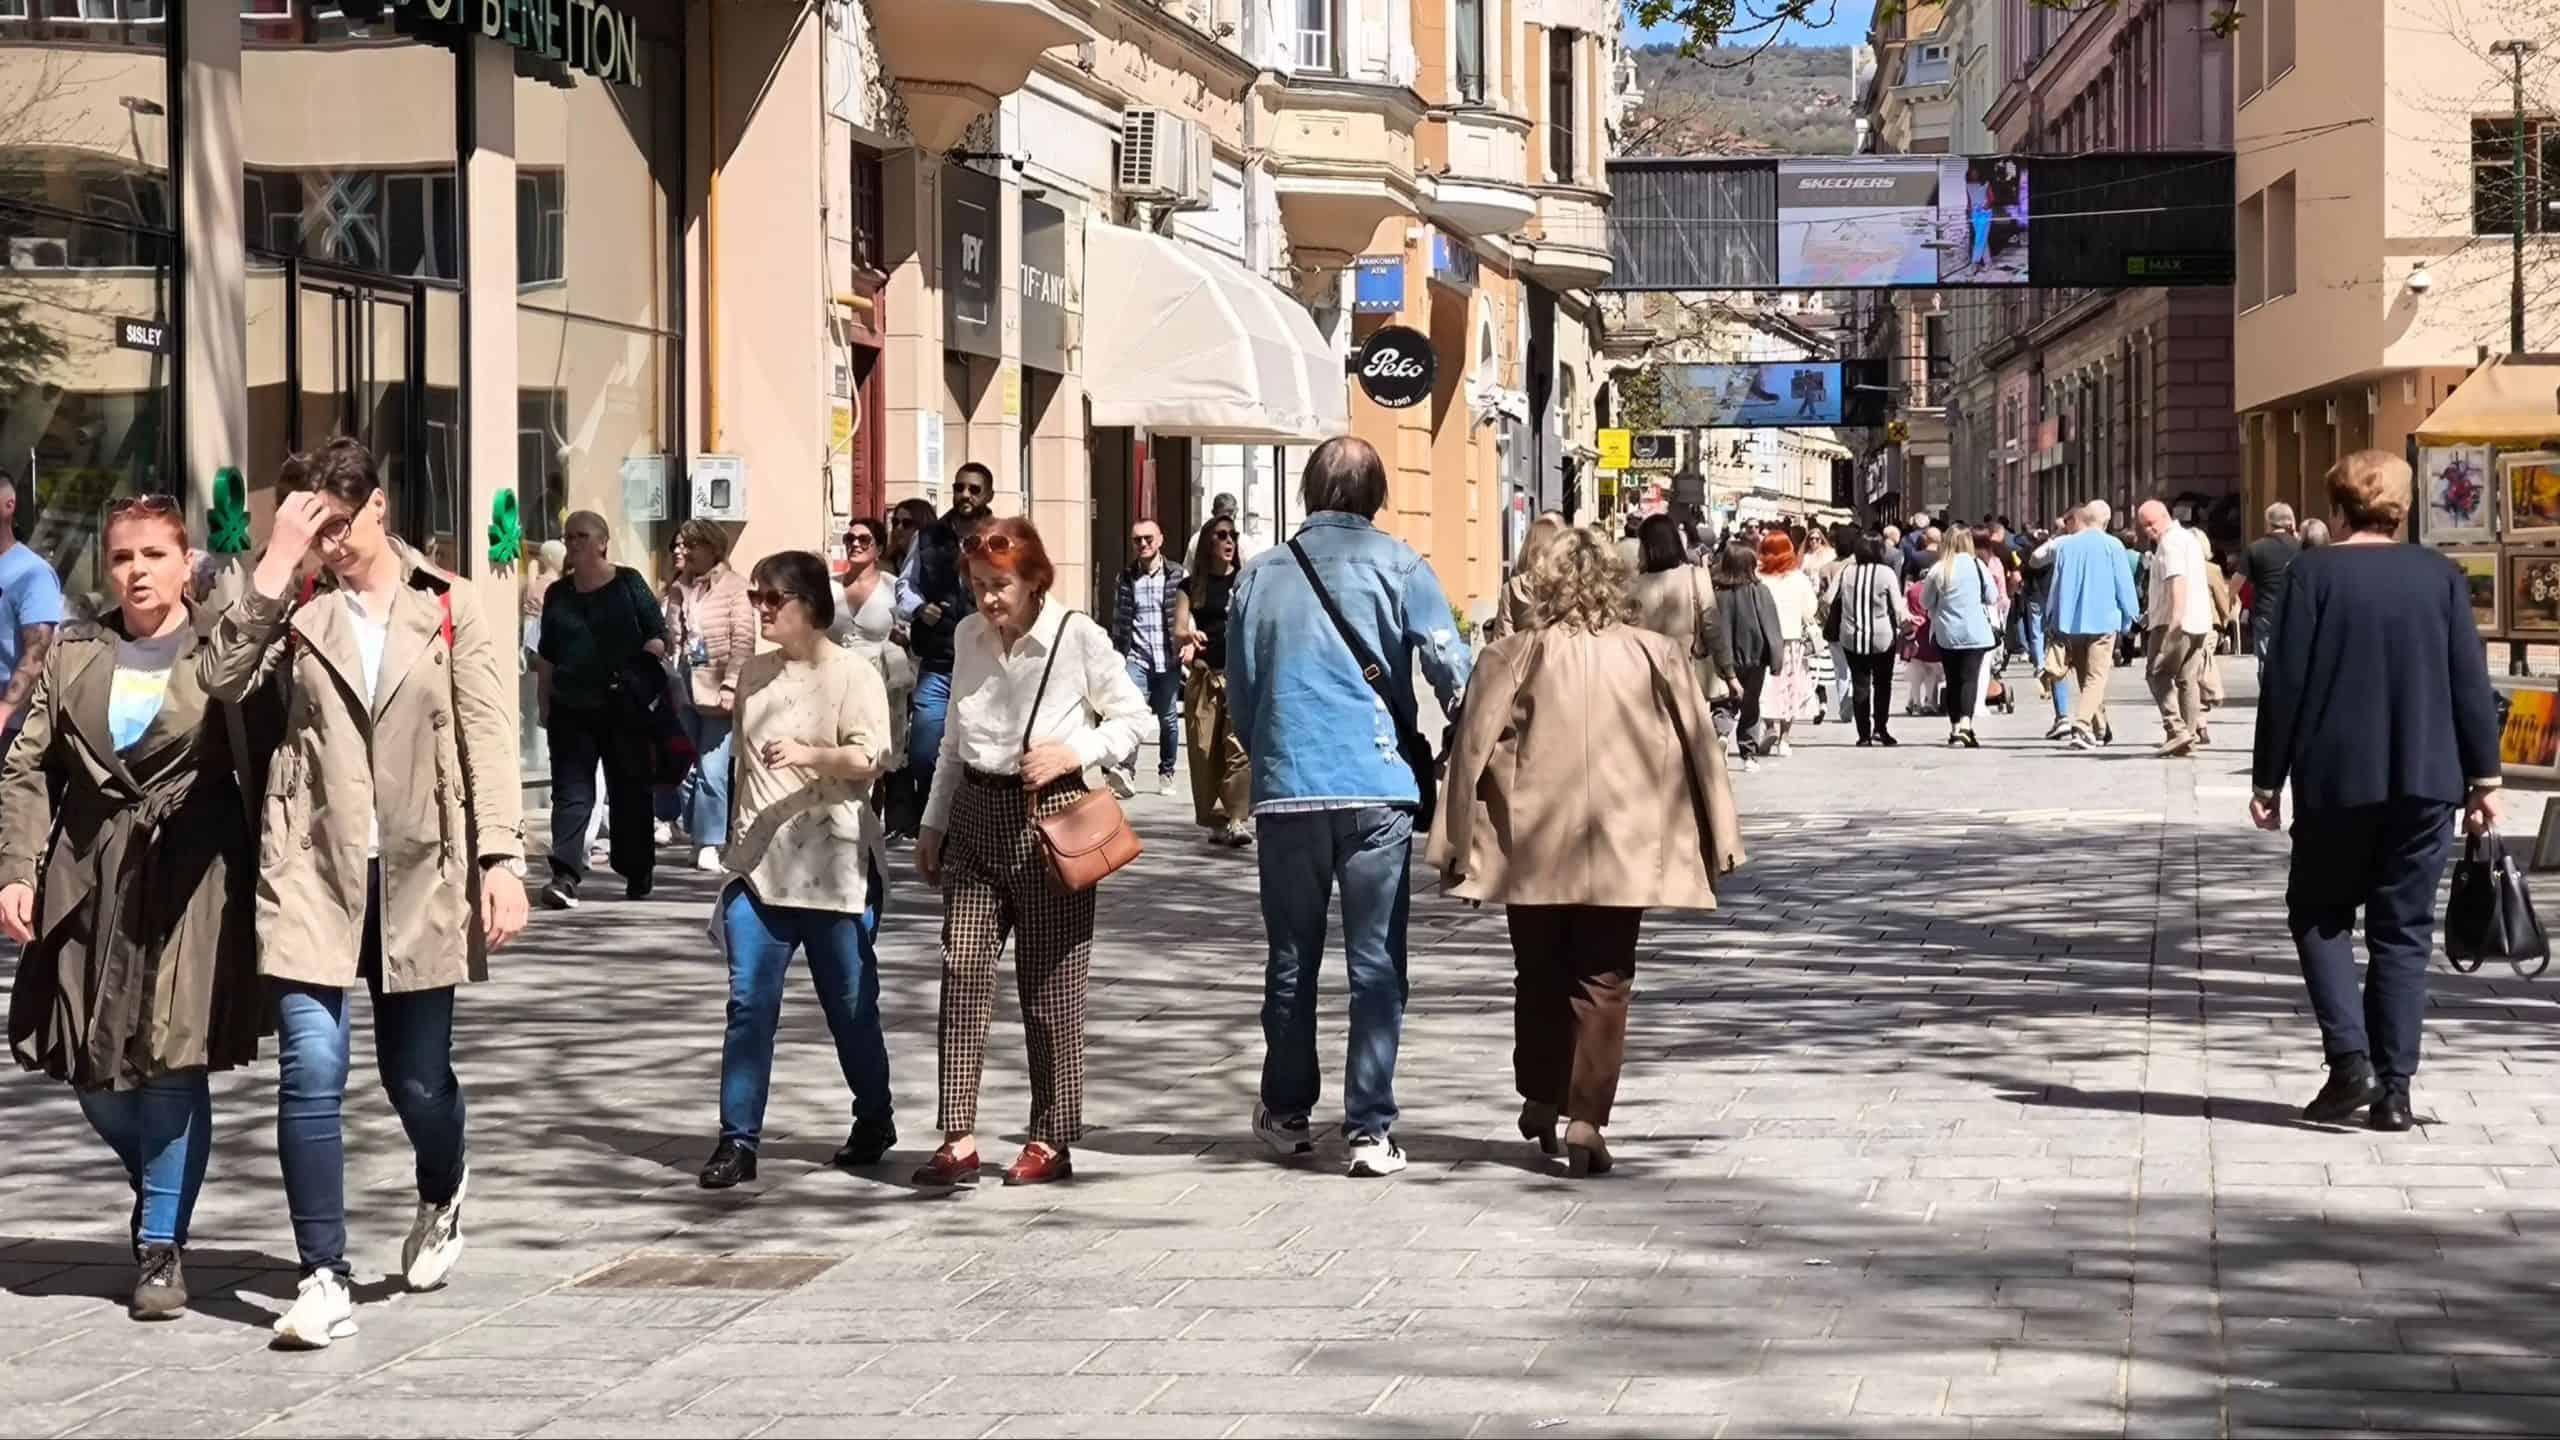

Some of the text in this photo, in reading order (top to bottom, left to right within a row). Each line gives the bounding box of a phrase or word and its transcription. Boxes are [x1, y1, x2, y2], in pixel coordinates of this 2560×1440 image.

[1798, 176, 1897, 190] SKECHERS
[1358, 256, 1401, 265] BANKOMAT
[1370, 266, 1387, 275] ATM
[126, 324, 162, 347] SISLEY
